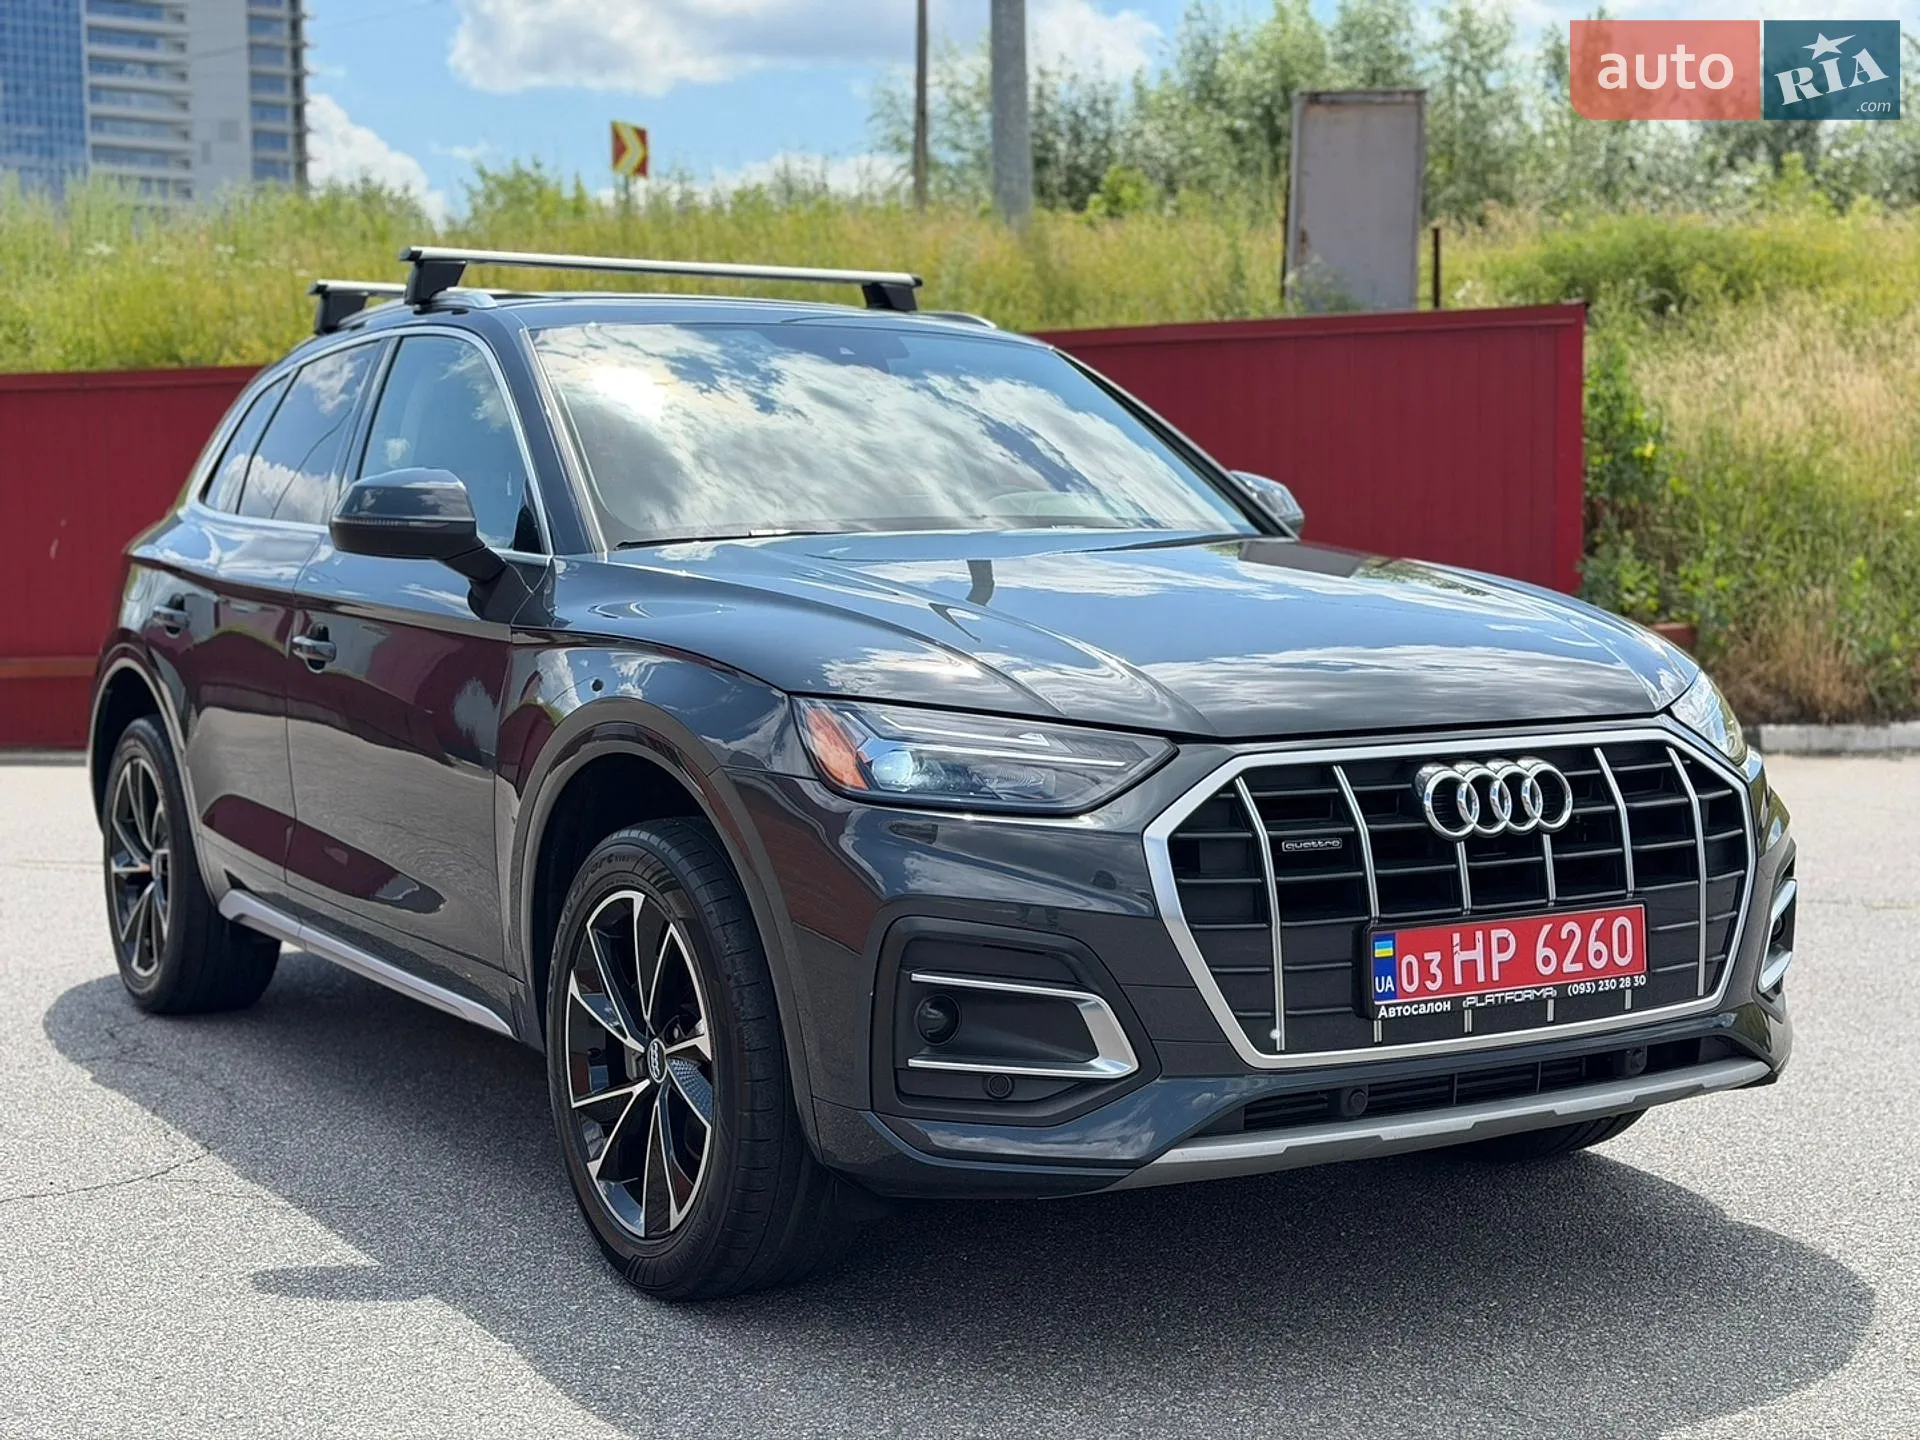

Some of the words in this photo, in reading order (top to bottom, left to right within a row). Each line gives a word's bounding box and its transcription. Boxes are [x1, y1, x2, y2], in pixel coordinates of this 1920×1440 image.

[1285, 840, 1341, 851] quattro
[1400, 951, 1443, 993] 03
[1452, 928, 1517, 986] HP
[1535, 915, 1634, 976] 6260
[1374, 975, 1395, 993] UA
[1377, 1000, 1452, 1019] Автосалон
[1567, 981, 1596, 997] (093)
[1597, 978, 1618, 992] 230
[1618, 976, 1632, 989] 28
[1633, 974, 1647, 987] 30
